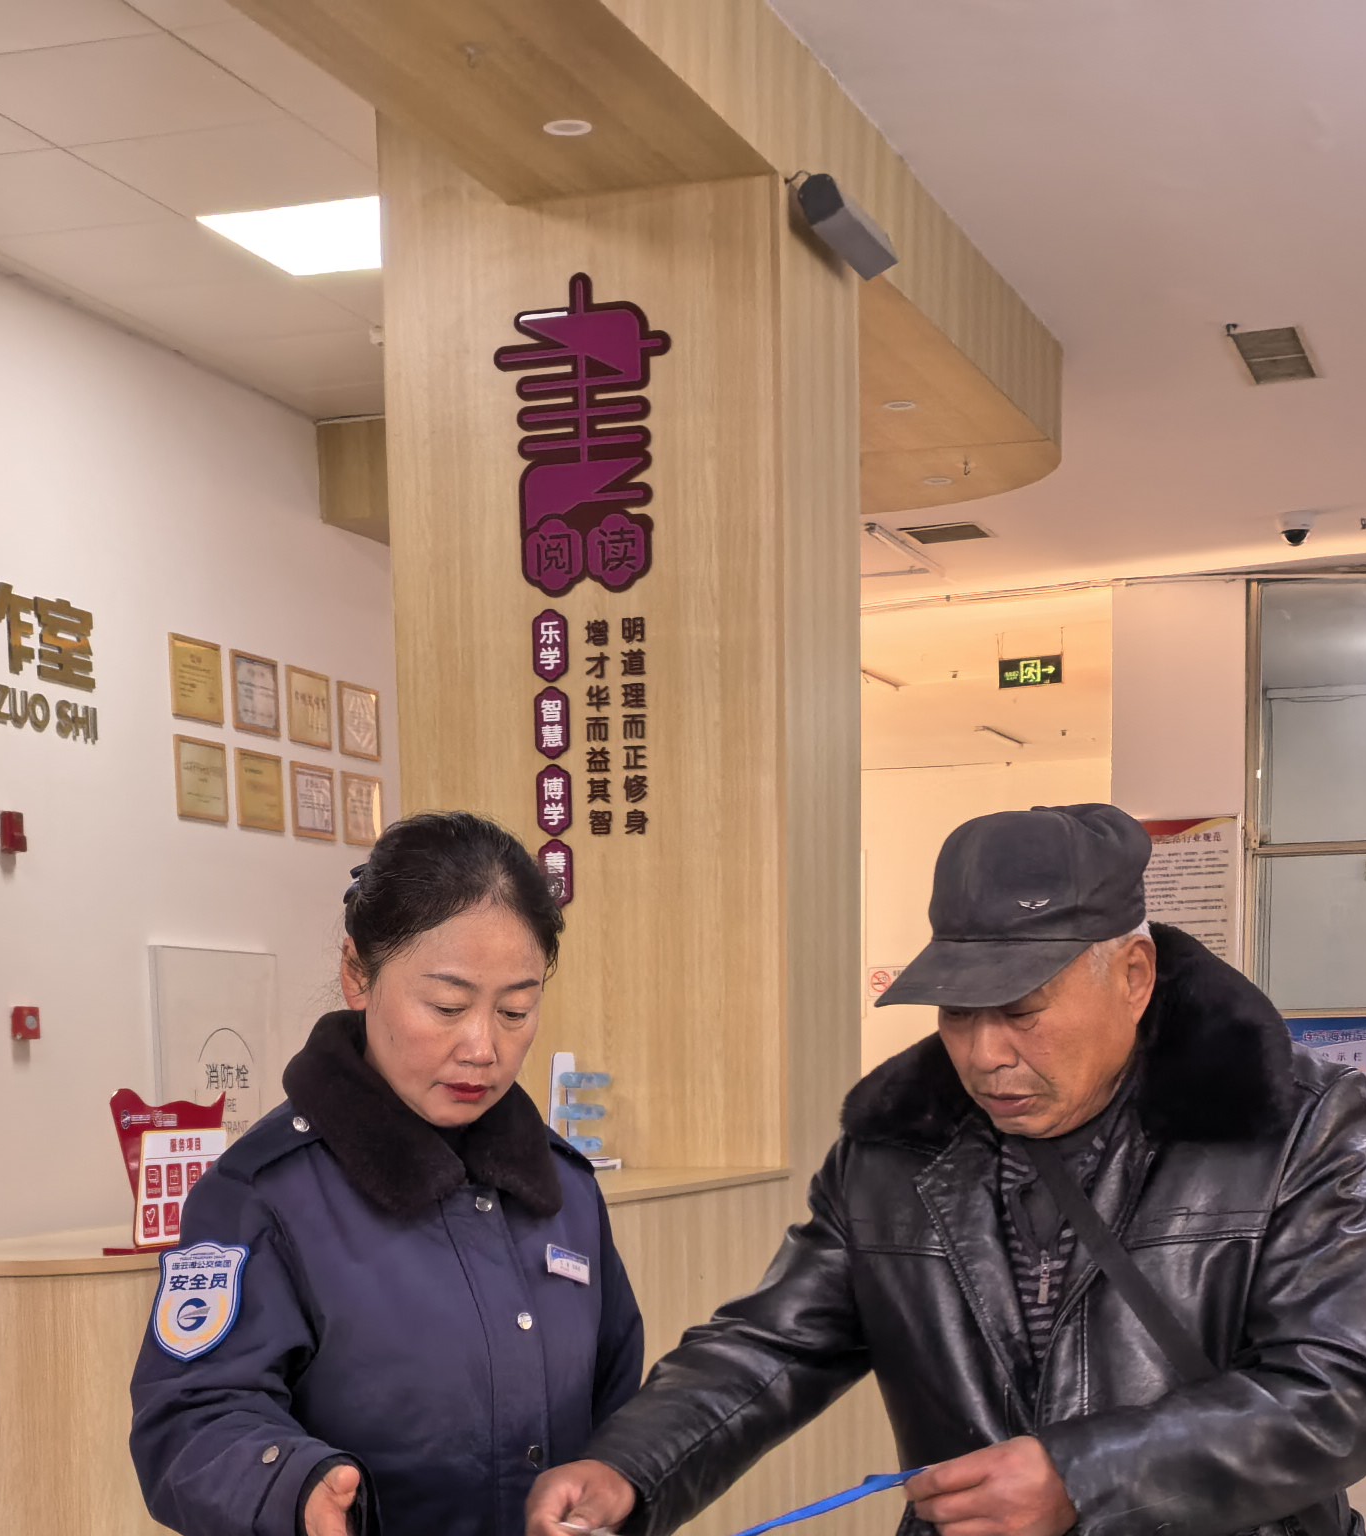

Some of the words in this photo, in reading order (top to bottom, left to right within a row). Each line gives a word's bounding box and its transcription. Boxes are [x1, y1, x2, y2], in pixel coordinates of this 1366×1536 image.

[537, 527, 636, 576] 阅读
[540, 620, 561, 671] 乐学
[55, 699, 98, 745] SHI
[541, 699, 563, 748] 智慧
[585, 619, 613, 836] 增才华而益其智
[621, 616, 649, 836] 明道理而正修身
[543, 777, 565, 826] 博学
[206, 1064, 250, 1090] 消防栓
[170, 1137, 202, 1152] 服务项目
[169, 1272, 228, 1291] 安全员
